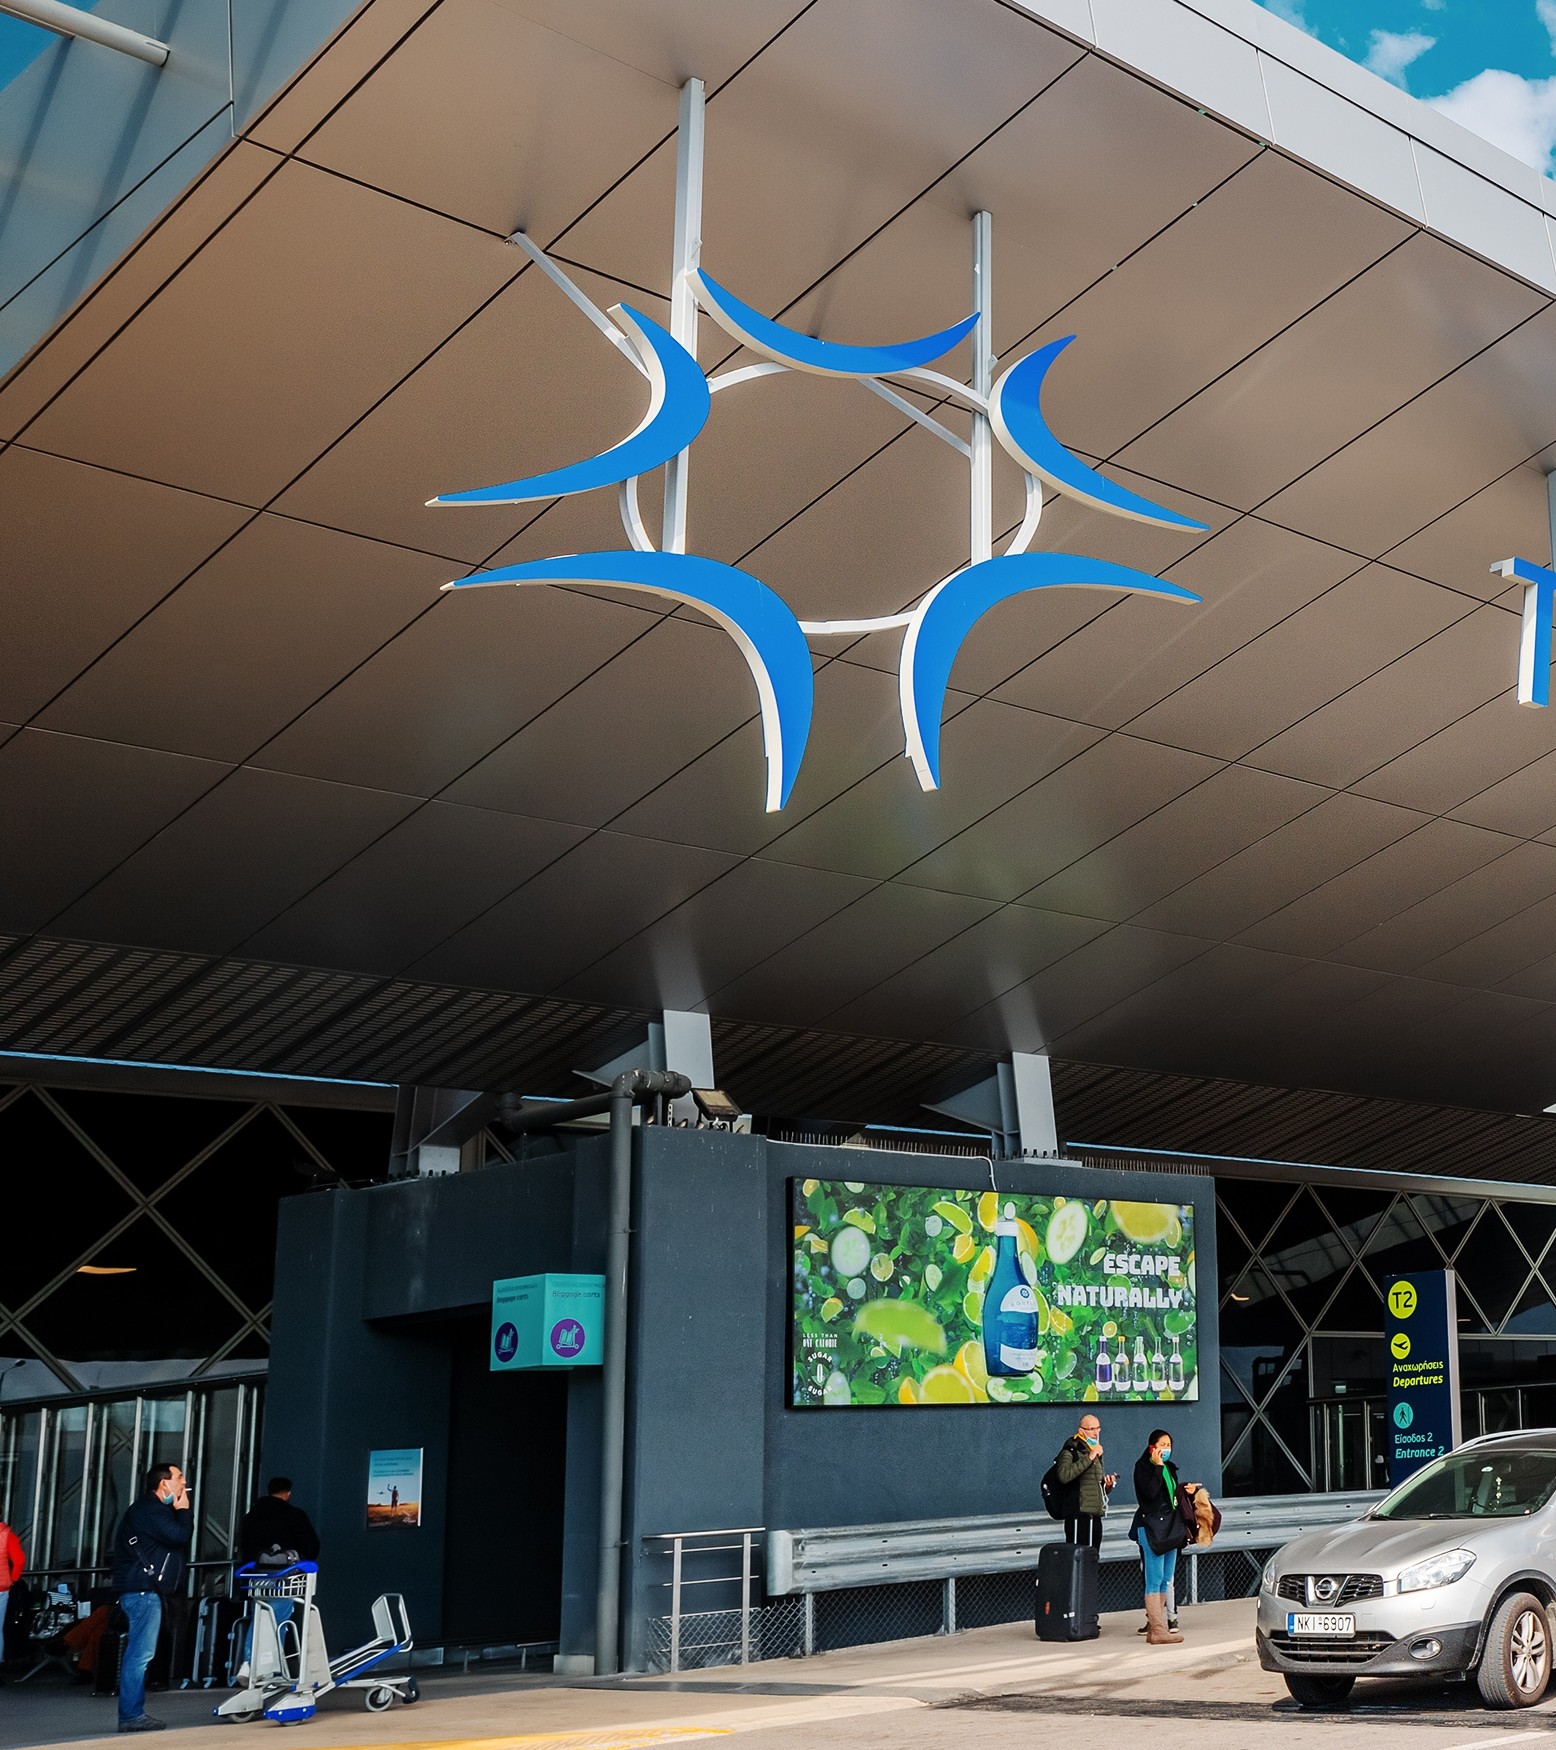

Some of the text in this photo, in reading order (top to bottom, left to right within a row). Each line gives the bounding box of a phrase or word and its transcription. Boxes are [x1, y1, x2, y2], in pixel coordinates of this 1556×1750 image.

[1103, 1253, 1181, 1277] ESCAPE
[1057, 1285, 1183, 1309] NATURALLY
[1392, 1290, 1413, 1309] T2
[807, 1351, 833, 1363] SUGAR
[1392, 1360, 1444, 1374] Αναχωρήσεις
[1392, 1374, 1444, 1389] Departures
[807, 1385, 833, 1396] SUGAR
[1394, 1431, 1434, 1445] Είσοδος 2
[1395, 1445, 1445, 1459] Entrance 2
